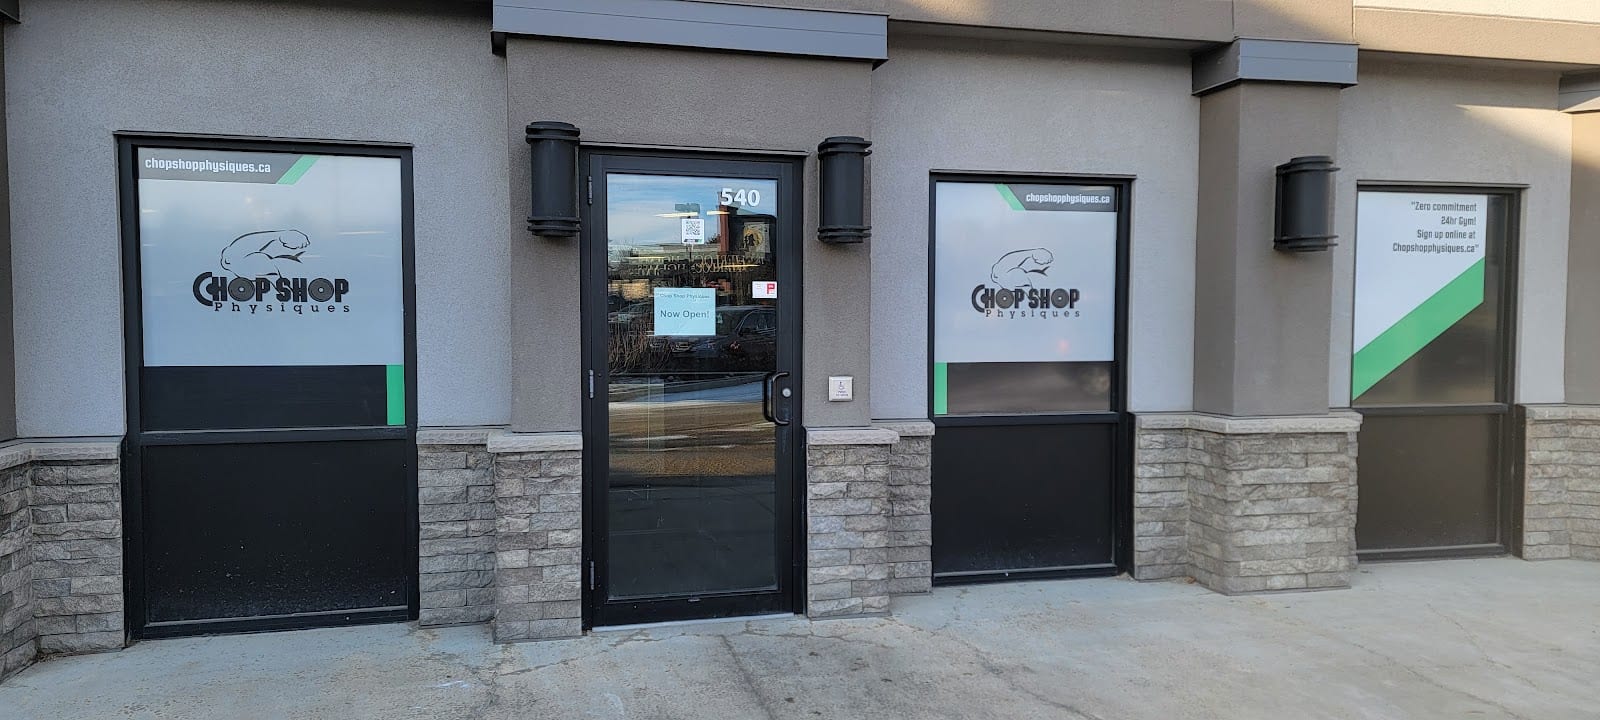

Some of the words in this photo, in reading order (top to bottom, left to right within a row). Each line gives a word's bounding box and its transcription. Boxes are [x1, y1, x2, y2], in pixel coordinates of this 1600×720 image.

[145, 157, 271, 173] chopshopphysiques.ca
[720, 187, 760, 207] 540
[1026, 193, 1110, 204] chopshopphysiques.ca
[1433, 202, 1477, 212] commitment
[1441, 216, 1457, 225] 24hr
[1458, 216, 1477, 227] Gym!
[1417, 229, 1433, 240] Sign
[1434, 231, 1443, 240] up
[1445, 230, 1467, 239] online
[1468, 231, 1476, 239] at
[276, 277, 349, 302] SHOP
[1028, 288, 1080, 309] SHOP
[214, 302, 350, 314] Physiques
[660, 310, 680, 318] Now
[683, 310, 709, 320] Open!
[985, 309, 1080, 319] Physiques
